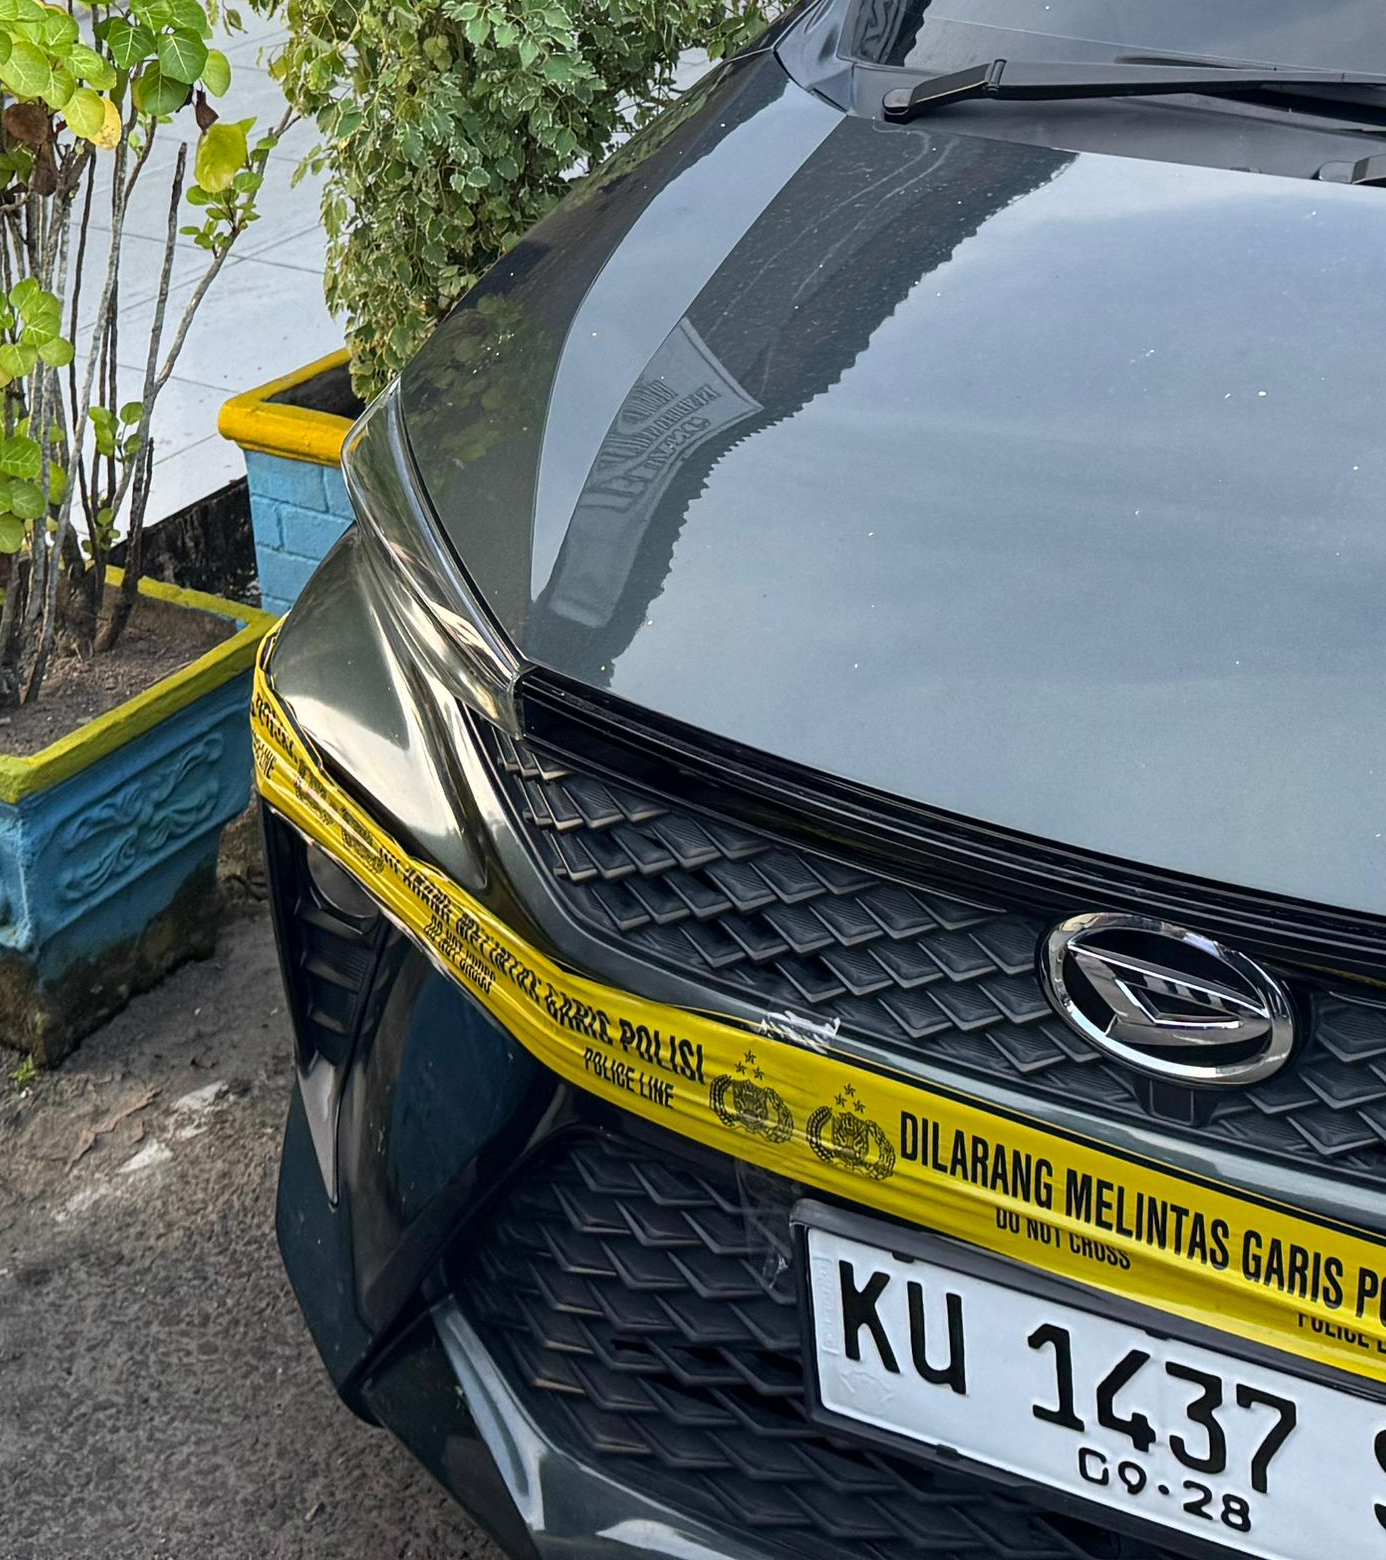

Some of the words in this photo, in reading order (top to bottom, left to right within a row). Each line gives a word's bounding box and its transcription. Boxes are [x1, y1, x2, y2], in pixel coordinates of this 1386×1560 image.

[583, 1047, 635, 1093] POLICE
[638, 1067, 675, 1110] LINE
[619, 1017, 706, 1085] POLISI
[900, 1110, 1054, 1211] DILARANG
[1064, 1168, 1230, 1271] MELINTAS
[1241, 1229, 1344, 1310] GARIS
[838, 1258, 967, 1396] KU
[1026, 1322, 1298, 1496] 1437
